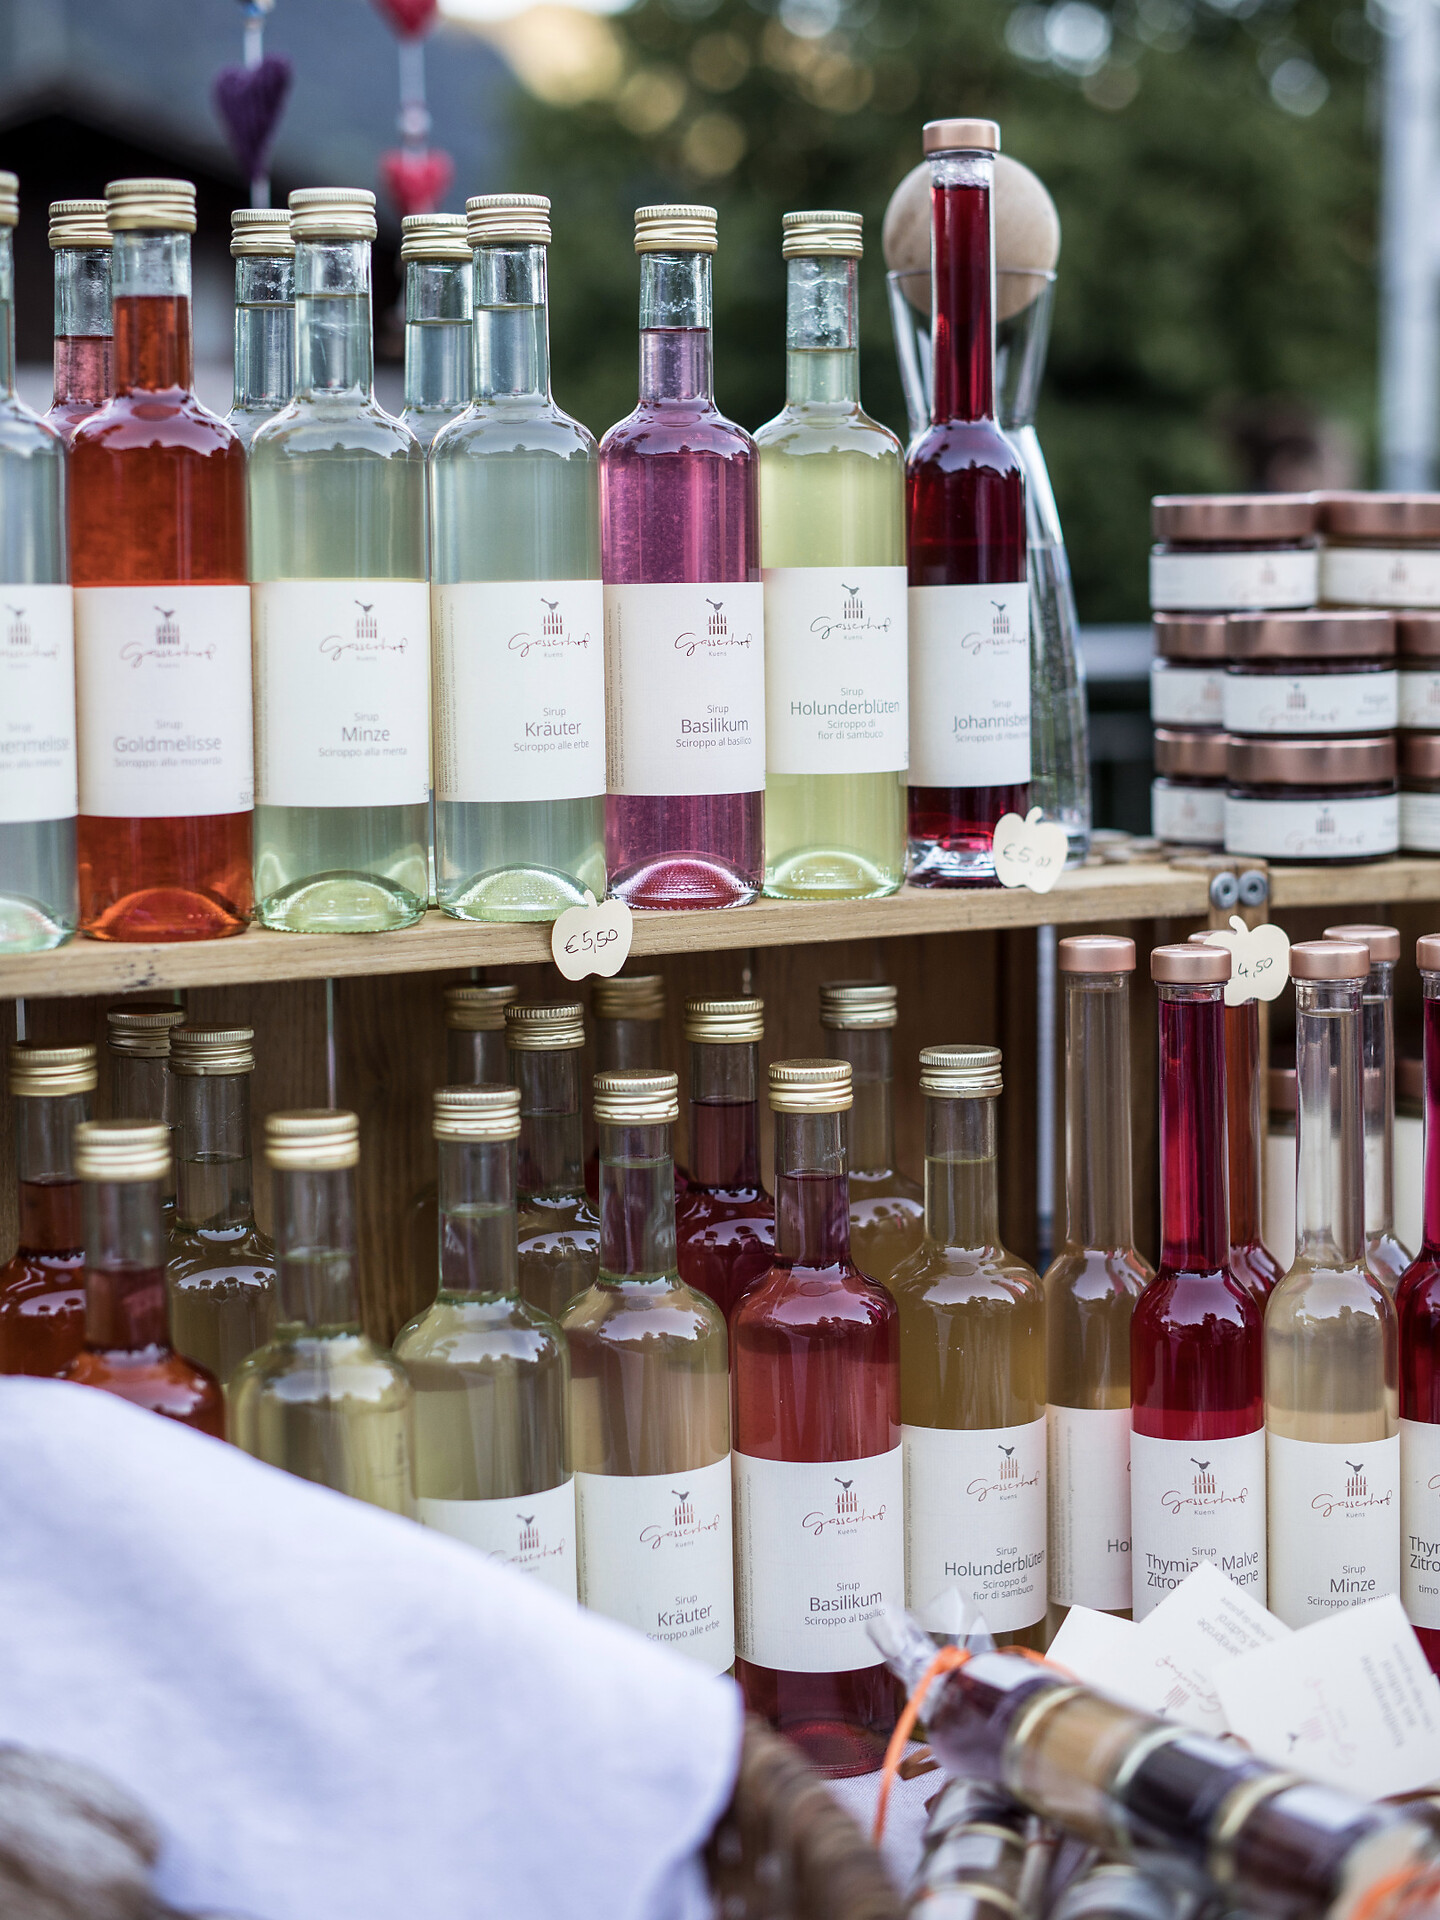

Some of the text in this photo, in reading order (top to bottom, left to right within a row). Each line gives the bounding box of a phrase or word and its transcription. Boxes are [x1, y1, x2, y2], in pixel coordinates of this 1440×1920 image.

[810, 616, 892, 640] Gasserhof
[508, 632, 590, 657] Gasserhof
[674, 632, 752, 656] Gasserhof
[840, 687, 864, 698] Sirup
[543, 707, 566, 719] Sirup
[707, 704, 729, 715] Sirup
[790, 699, 900, 716] Holunderblüten
[354, 712, 379, 723] Sirup
[525, 720, 581, 738] Kräuter
[681, 717, 749, 734] Basilikum
[827, 720, 876, 731] Sciroppo di
[341, 727, 391, 742] Minze
[817, 730, 884, 740] fior di sambuco
[955, 733, 993, 743] Sciroppo
[113, 735, 222, 753] Goldmelisse
[514, 740, 589, 752] Sciroppo alle erbe
[675, 737, 752, 749] Sciroppo al basilico
[318, 747, 362, 758] Sciroppo
[364, 746, 381, 756] alla
[967, 1470, 1040, 1502] Gasserhof
[1161, 1487, 1248, 1515] Gasserhof
[1311, 1489, 1393, 1518] Gasserhof
[1194, 1508, 1215, 1516] Kuens
[1346, 1511, 1365, 1519] Kuens
[802, 1504, 887, 1536] Gasserhof
[640, 1515, 719, 1549] Gasserhof
[996, 1546, 1018, 1558] Sirup
[1192, 1547, 1216, 1557] Sirup
[944, 1550, 1045, 1577] Holunderblüten
[1146, 1552, 1259, 1574] Thymia Malve
[1342, 1565, 1366, 1574] Sirup
[836, 1580, 860, 1593] Sirup
[982, 1575, 1028, 1591] Sciroppo di
[1330, 1578, 1376, 1593] Minze
[1418, 1585, 1439, 1595] timo
[675, 1593, 698, 1605] Sirup
[973, 1584, 1034, 1601] fior di sambuco
[809, 1590, 882, 1612] Basilikum
[1307, 1596, 1349, 1608] Sciroppo
[657, 1603, 712, 1627] Kräuter
[804, 1608, 886, 1627] Sciroppo al basilico
[646, 1620, 720, 1642] Sciroppo alle erbe
